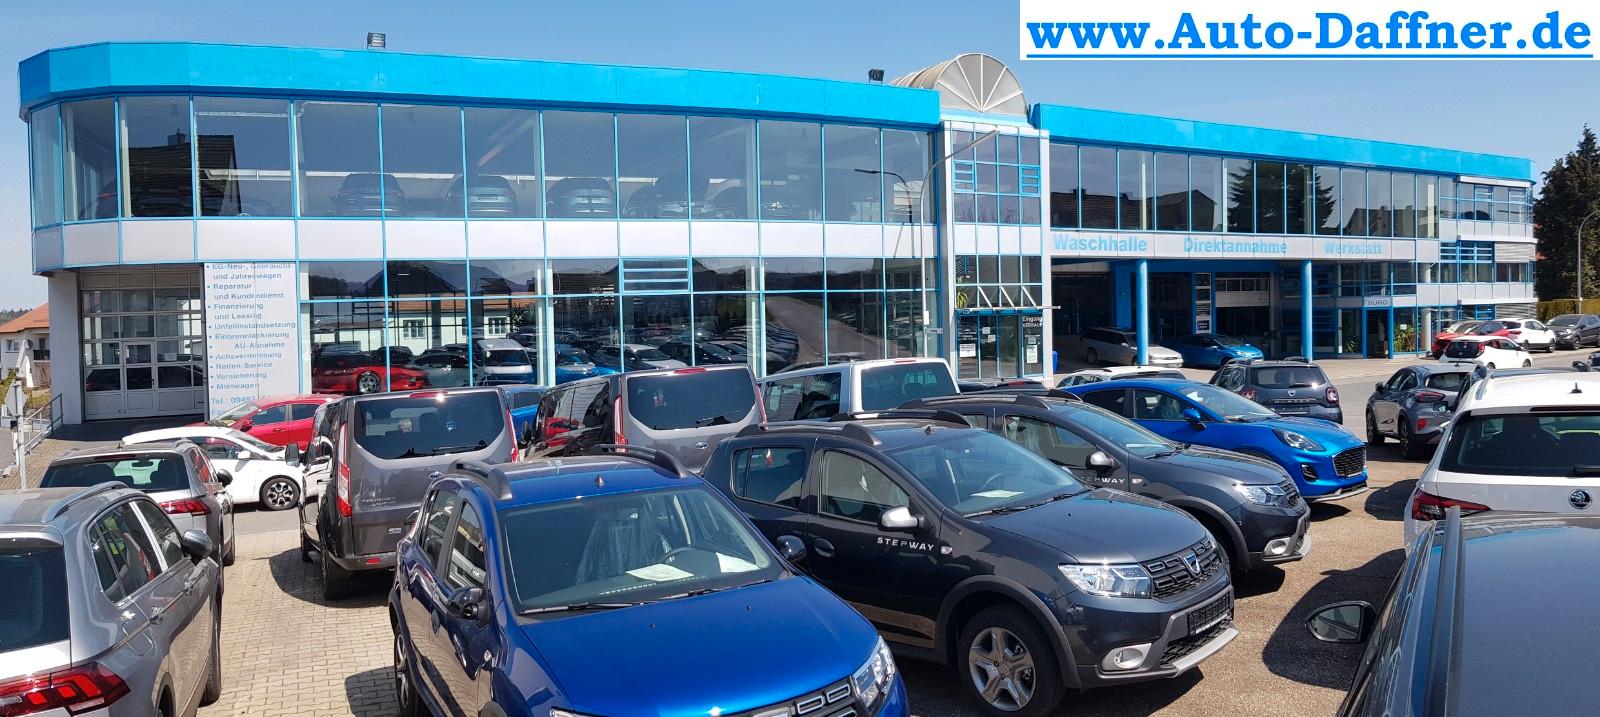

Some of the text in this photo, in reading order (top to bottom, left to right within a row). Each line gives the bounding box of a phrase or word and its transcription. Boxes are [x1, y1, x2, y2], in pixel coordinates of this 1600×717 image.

[1054, 233, 1147, 251] Waschhalle
[1184, 236, 1288, 255] Direktannahme
[1325, 240, 1381, 255] Werkstatt
[213, 283, 252, 291] Reparatur
[232, 312, 262, 320] Leasing
[877, 537, 934, 551] STEPWAY
